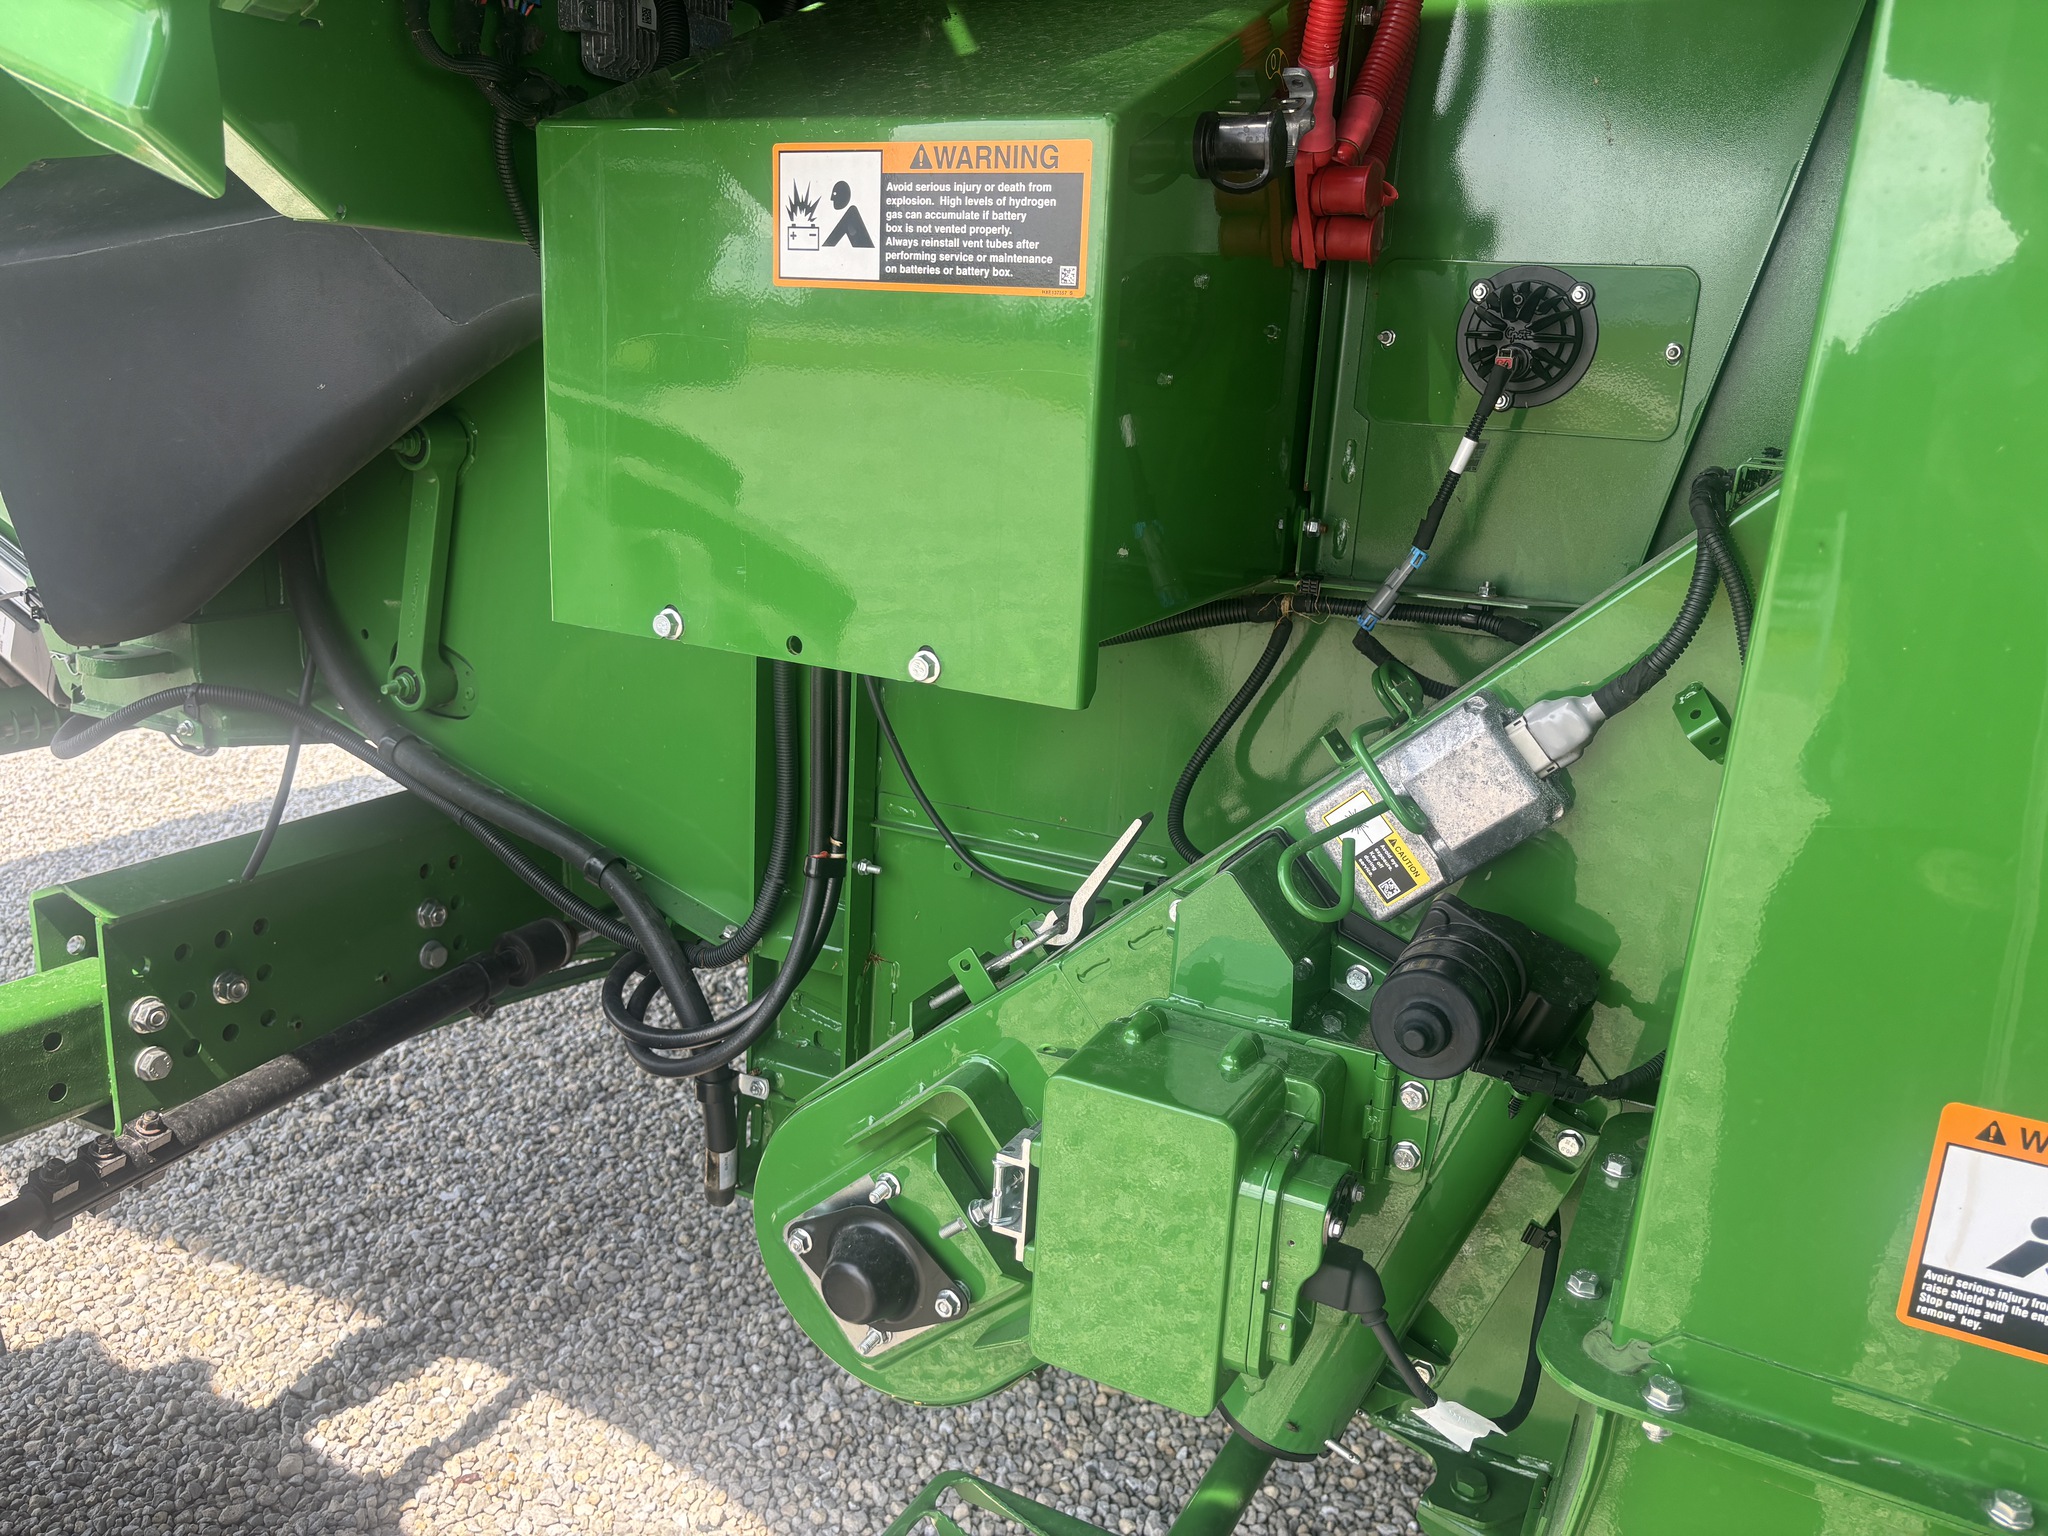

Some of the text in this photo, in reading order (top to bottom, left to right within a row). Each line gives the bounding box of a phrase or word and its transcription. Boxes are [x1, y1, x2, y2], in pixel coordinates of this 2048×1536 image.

[934, 144, 1060, 170] WARNING
[886, 181, 1052, 194] Avoid serious injury or death from
[886, 196, 1057, 209] explosion. High levels of hydrogen
[886, 210, 1027, 223] gas can accumulate if battery
[885, 223, 1013, 237] box is not vented properly.
[885, 238, 1040, 250] Always reinstall vent tubes after
[885, 251, 1053, 264] performing service or maintenance
[885, 264, 1013, 278] on batteries or battery box.
[1363, 854, 1377, 872] during
[1369, 850, 1378, 862] Key
[1375, 848, 1392, 871] exposure.
[1380, 845, 1399, 868] Avoid eye
[1395, 846, 1420, 878] CAUTION
[1358, 858, 1373, 878] service.
[1924, 1269, 2048, 1312] Avoid serious injury fro
[1919, 1291, 2005, 1324] Stop engine and
[1921, 1282, 1949, 1296] raise
[1950, 1288, 1984, 1306] shield
[1985, 1298, 2009, 1313] with
[2010, 1304, 2029, 1319] the
[1916, 1305, 1983, 1331] remove key.
